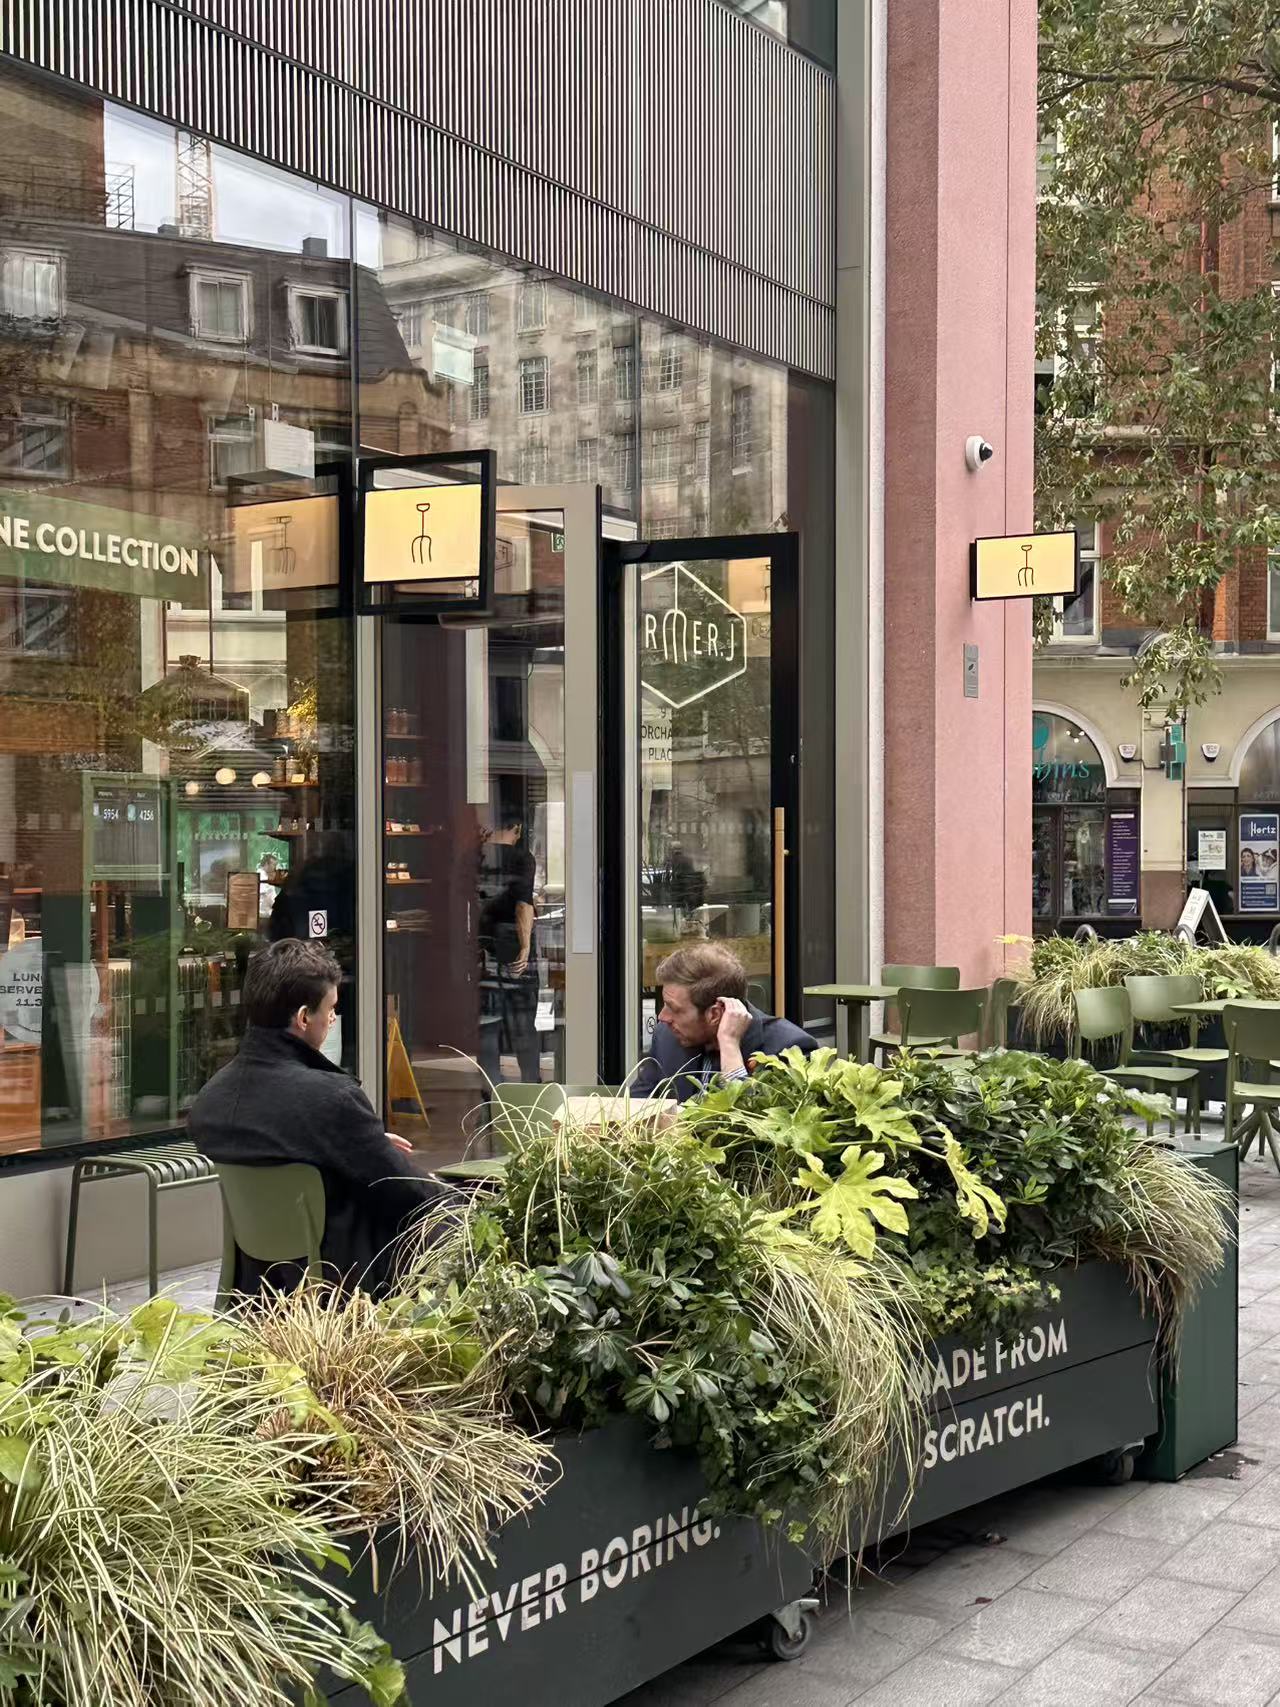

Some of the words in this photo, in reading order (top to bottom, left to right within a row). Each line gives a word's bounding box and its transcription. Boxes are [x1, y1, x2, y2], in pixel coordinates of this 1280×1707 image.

[36, 523, 198, 577] COLLECTION
[13, 972, 42, 982] LUN
[996, 1318, 1067, 1374] FROM
[924, 1394, 1050, 1469] SCRATCH.
[433, 1563, 567, 1674] NEVER
[581, 1498, 720, 1603] BORING.
